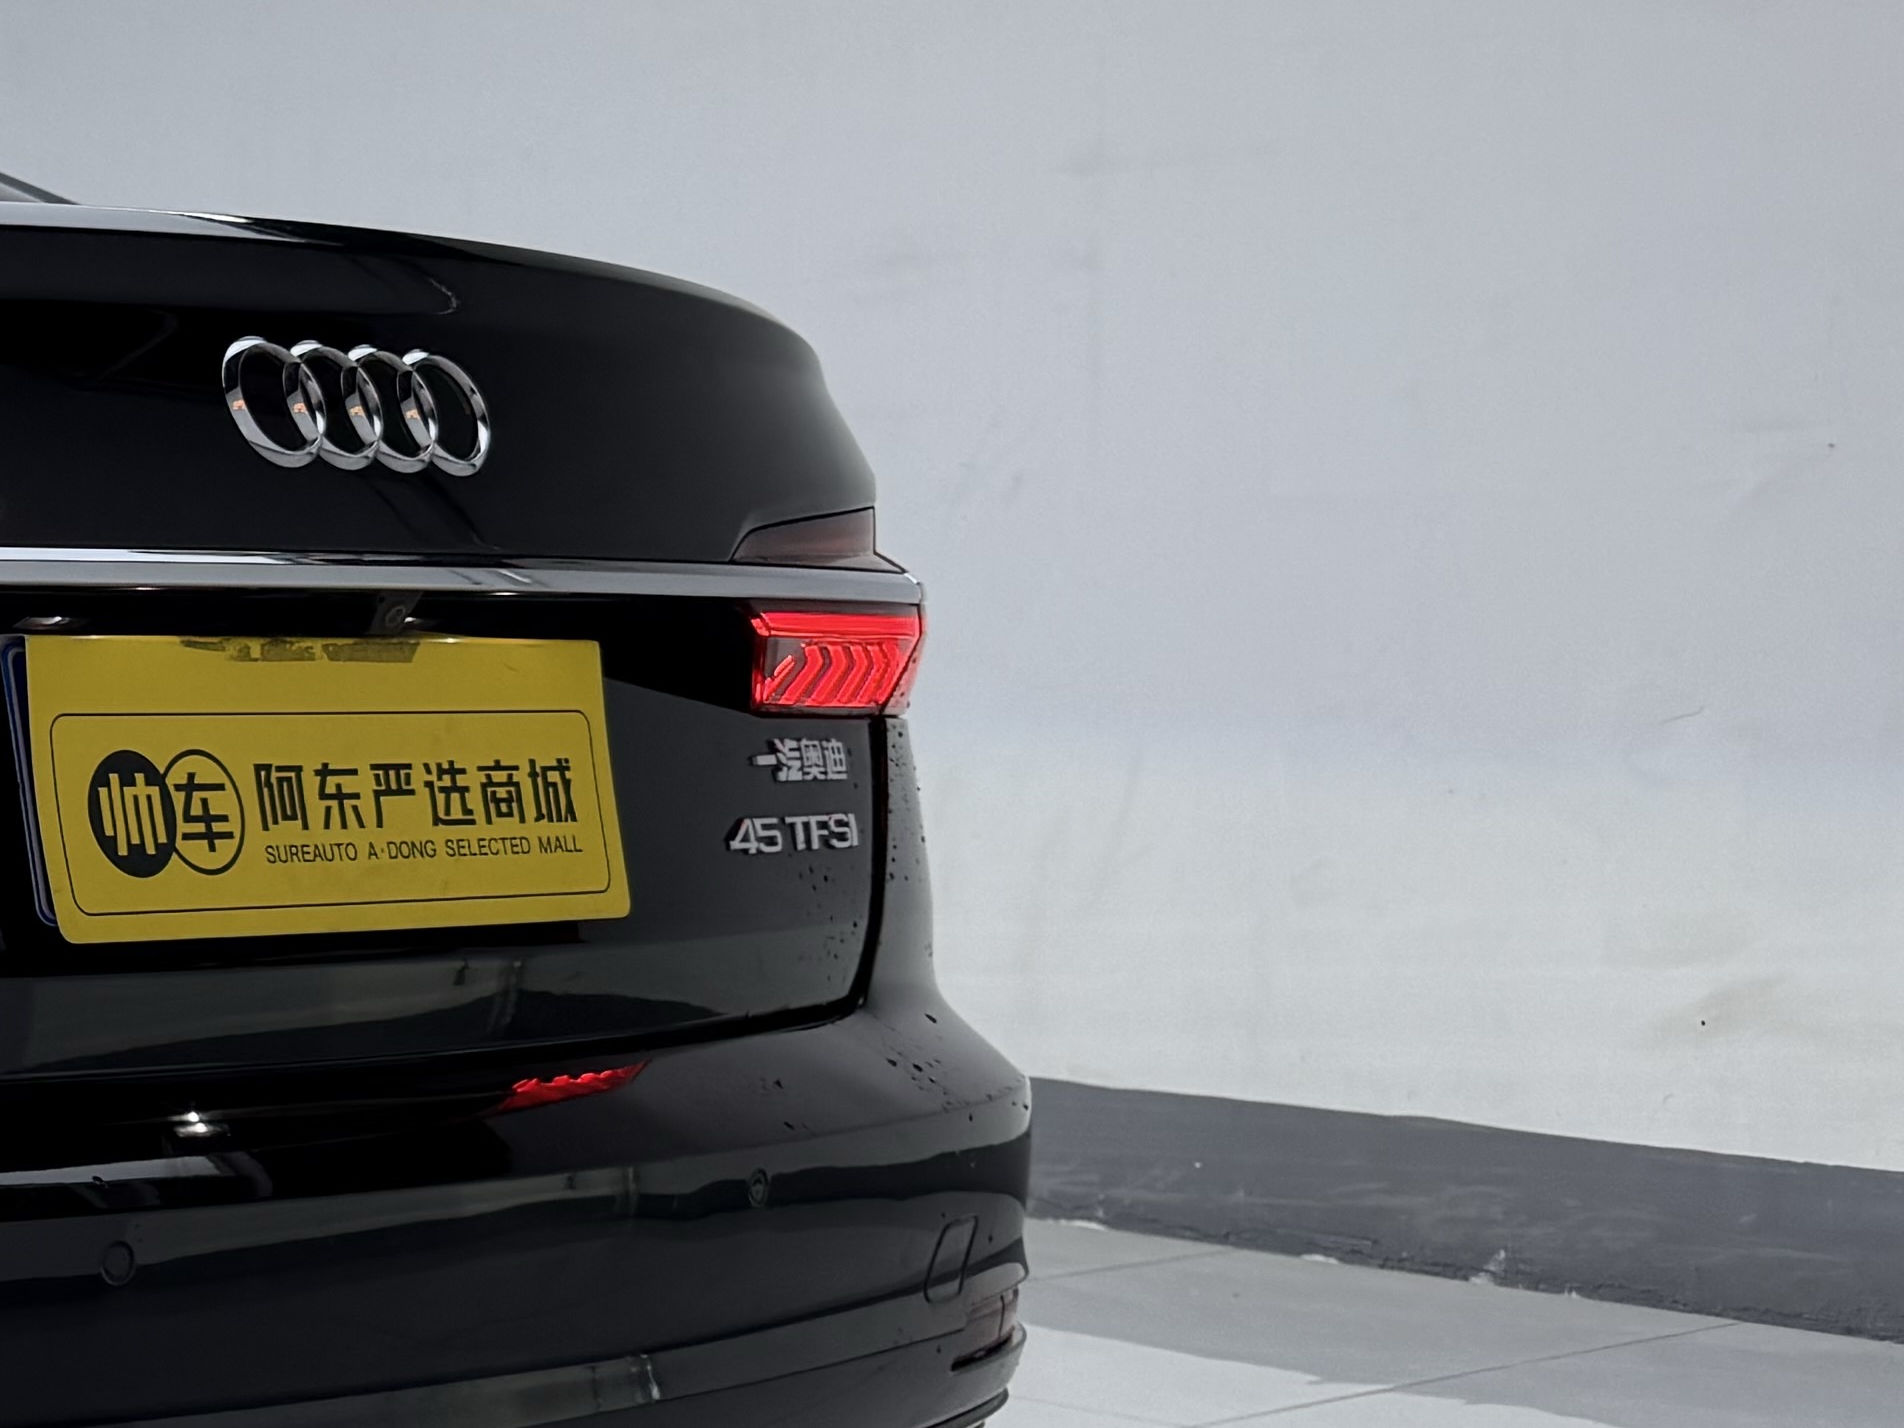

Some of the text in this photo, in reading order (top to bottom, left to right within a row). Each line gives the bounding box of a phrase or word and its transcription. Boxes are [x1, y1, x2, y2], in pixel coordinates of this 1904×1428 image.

[253, 758, 578, 832] 阿东严选商城
[265, 842, 358, 864] SUREAUTO
[445, 836, 531, 858] SELECTED
[538, 834, 583, 854] MALL
